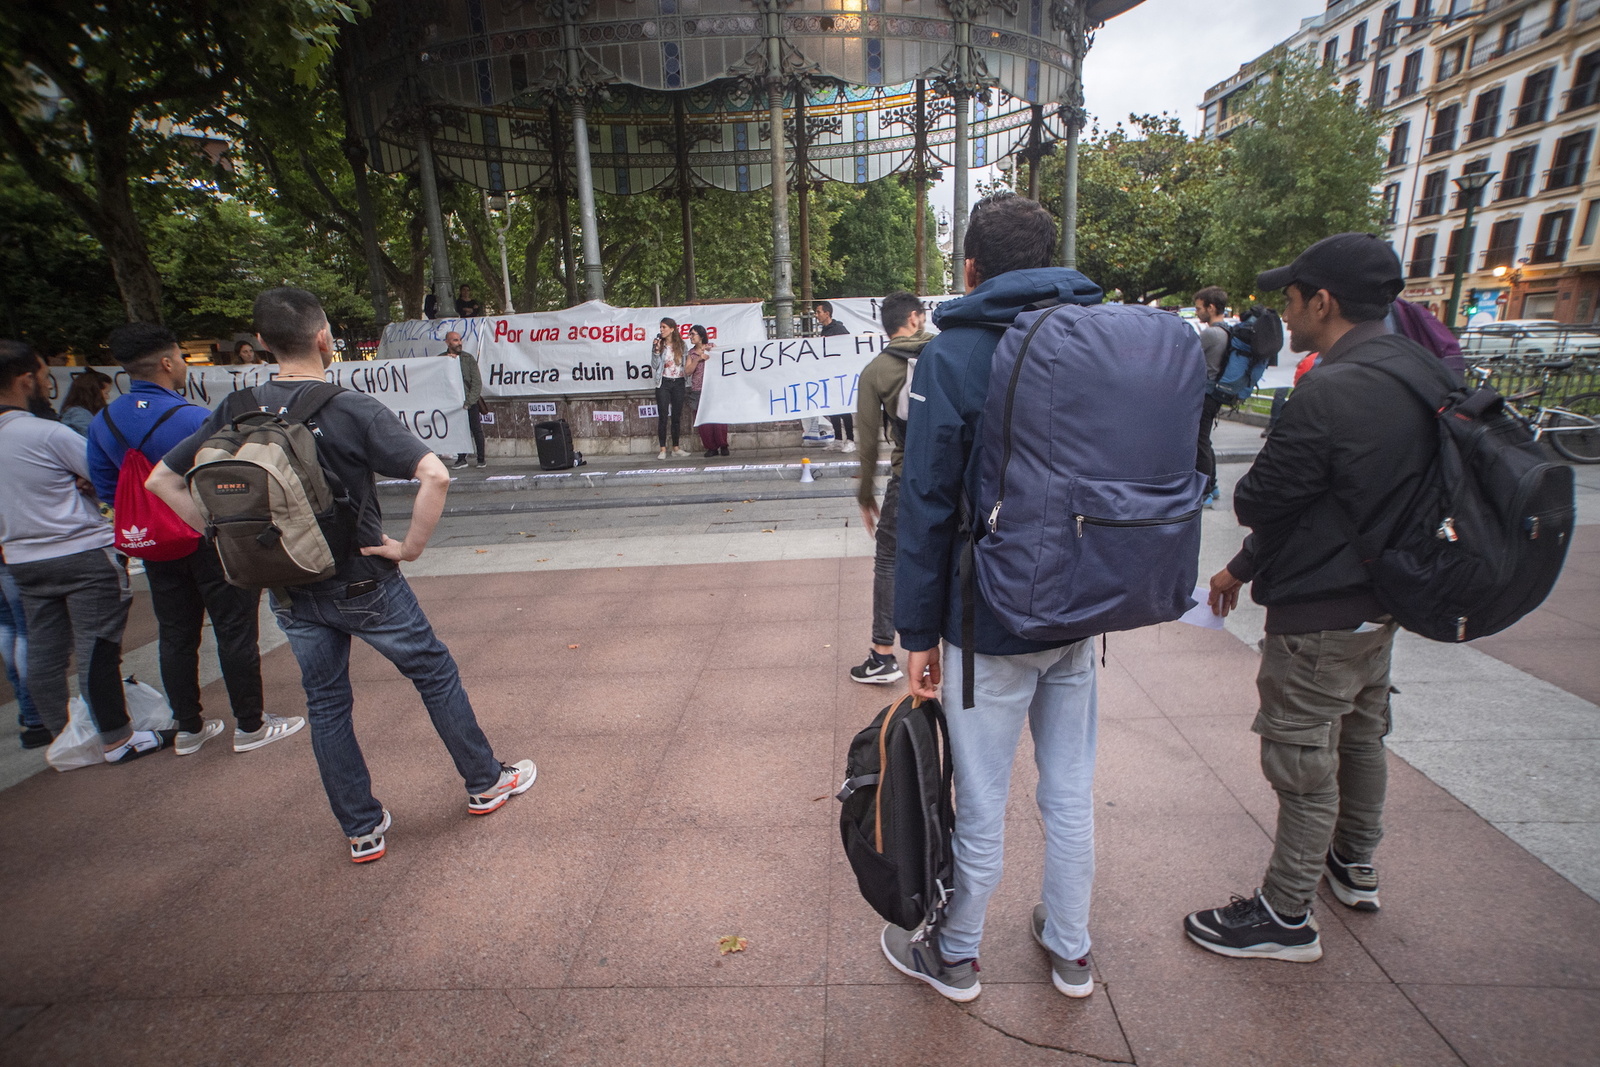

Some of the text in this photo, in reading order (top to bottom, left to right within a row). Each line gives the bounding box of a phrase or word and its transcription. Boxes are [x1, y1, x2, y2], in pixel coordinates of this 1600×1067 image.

[494, 319, 646, 343] Por una acogida
[721, 337, 841, 376] EUSKAL
[489, 360, 654, 386] Harrera duin ba
[769, 373, 860, 416] HIRITA
[398, 408, 449, 440] AGO
[120, 539, 157, 549] adidas
